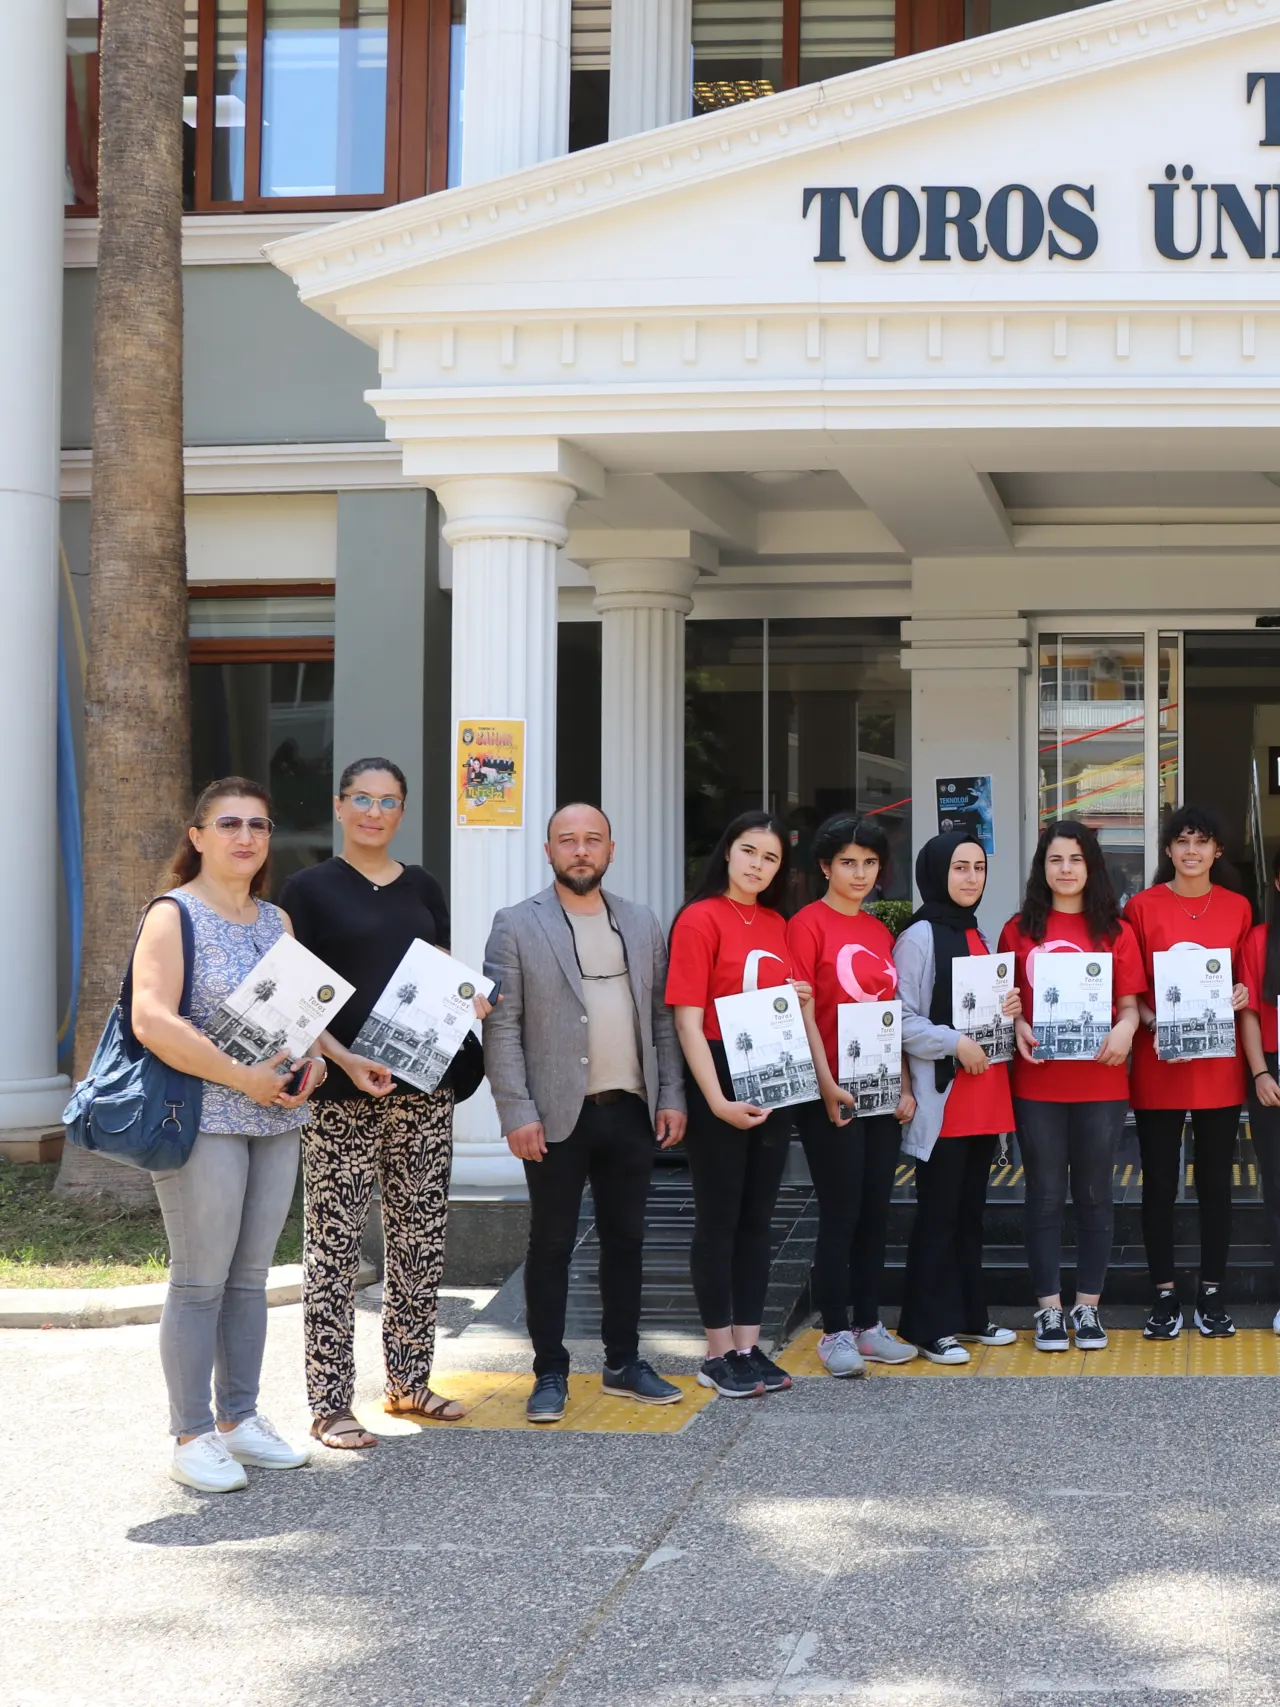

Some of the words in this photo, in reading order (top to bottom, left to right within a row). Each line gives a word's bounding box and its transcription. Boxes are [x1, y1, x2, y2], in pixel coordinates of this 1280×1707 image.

[802, 183, 1099, 263] TOROS
[308, 995, 327, 1013] Toros
[451, 993, 470, 1009] Toros
